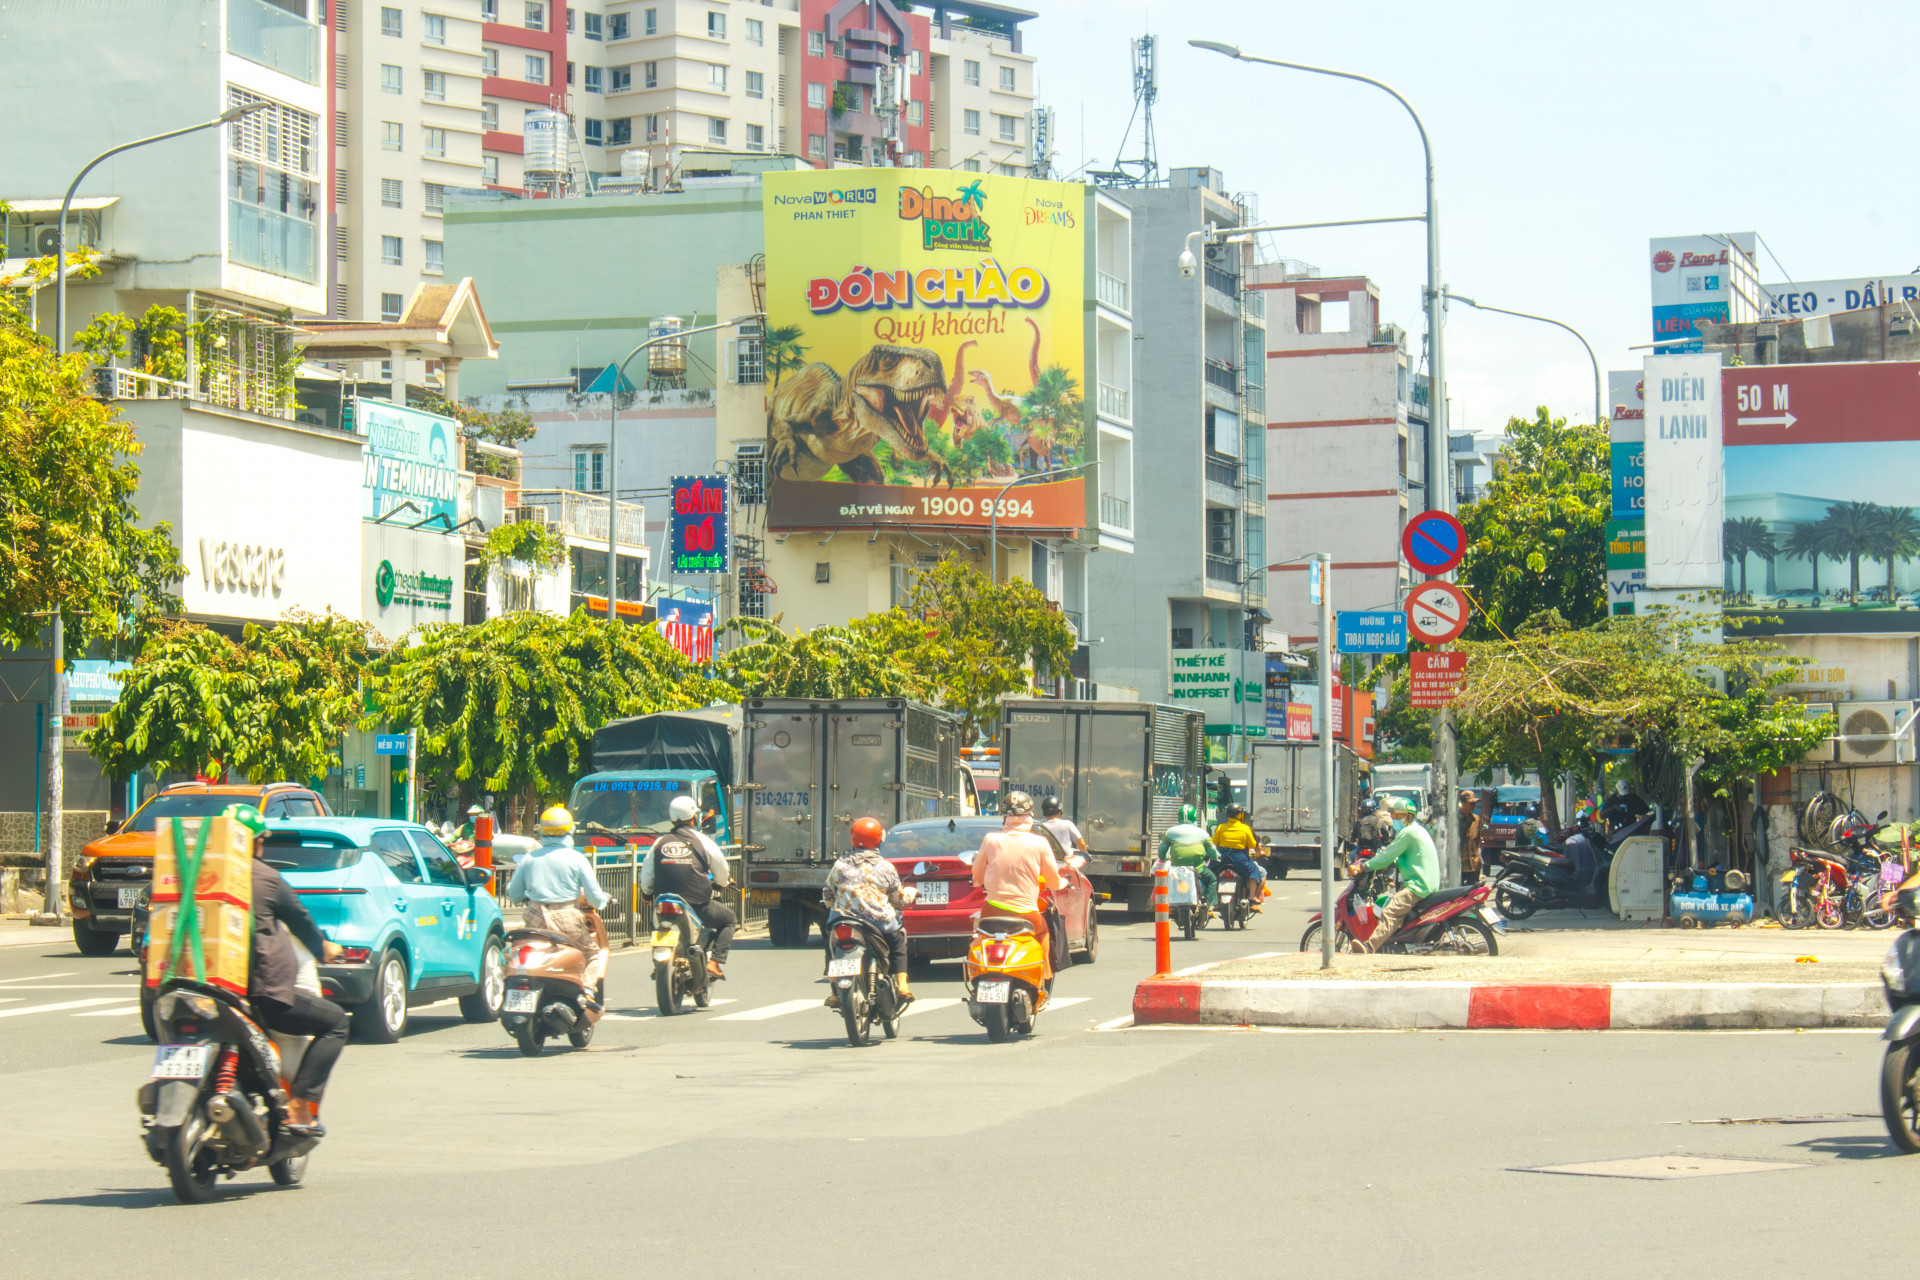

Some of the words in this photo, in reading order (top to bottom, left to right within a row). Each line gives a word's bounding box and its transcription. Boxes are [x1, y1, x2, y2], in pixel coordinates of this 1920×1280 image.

[899, 185, 974, 221] Dino
[1036, 198, 1062, 208] Nova
[793, 211, 823, 221] PHAN
[826, 209, 856, 219] THIET
[1024, 207, 1075, 228] DREAMS
[924, 218, 989, 248] park
[806, 264, 912, 315] ĐÓN
[915, 257, 1050, 310] CHÀO
[1770, 291, 1818, 315] KEO
[873, 314, 926, 344] Quý
[932, 309, 1006, 337] khách!
[1661, 372, 1705, 408] ĐIỆN
[1737, 384, 1762, 412] 50
[1773, 383, 1790, 411] M
[1659, 414, 1708, 445] LẠNH
[380, 455, 413, 496] TEM
[413, 461, 456, 503] NHÃN
[675, 480, 723, 514] CẦM
[840, 504, 866, 518] ĐẶT
[867, 503, 883, 515] VÉ
[884, 505, 916, 516] NGAY
[921, 496, 974, 516] 1900
[684, 516, 714, 551] ĐỒ
[1359, 614, 1386, 626] ĐƯỜNG
[1344, 632, 1365, 648] THOẠI
[1366, 632, 1385, 648] NGỌC
[1174, 653, 1207, 667] THIẾT
[1208, 652, 1226, 667] KẾ
[1427, 653, 1450, 669] CẤM
[1173, 672, 1186, 683] IN
[1186, 672, 1230, 682] NHANH
[1808, 664, 1826, 683] MÁY
[1827, 666, 1846, 683] BƠM
[1173, 688, 1186, 698] IN
[1187, 688, 1230, 698] OFFSET
[1013, 714, 1050, 723] ISUZU
[394, 740, 405, 750] 711
[594, 781, 609, 792] LH:
[665, 781, 679, 792] 80
[1263, 786, 1280, 794] 2556
[1265, 778, 1278, 786] 54U
[755, 791, 809, 806] 51C-247.76
[923, 882, 941, 893] 51H
